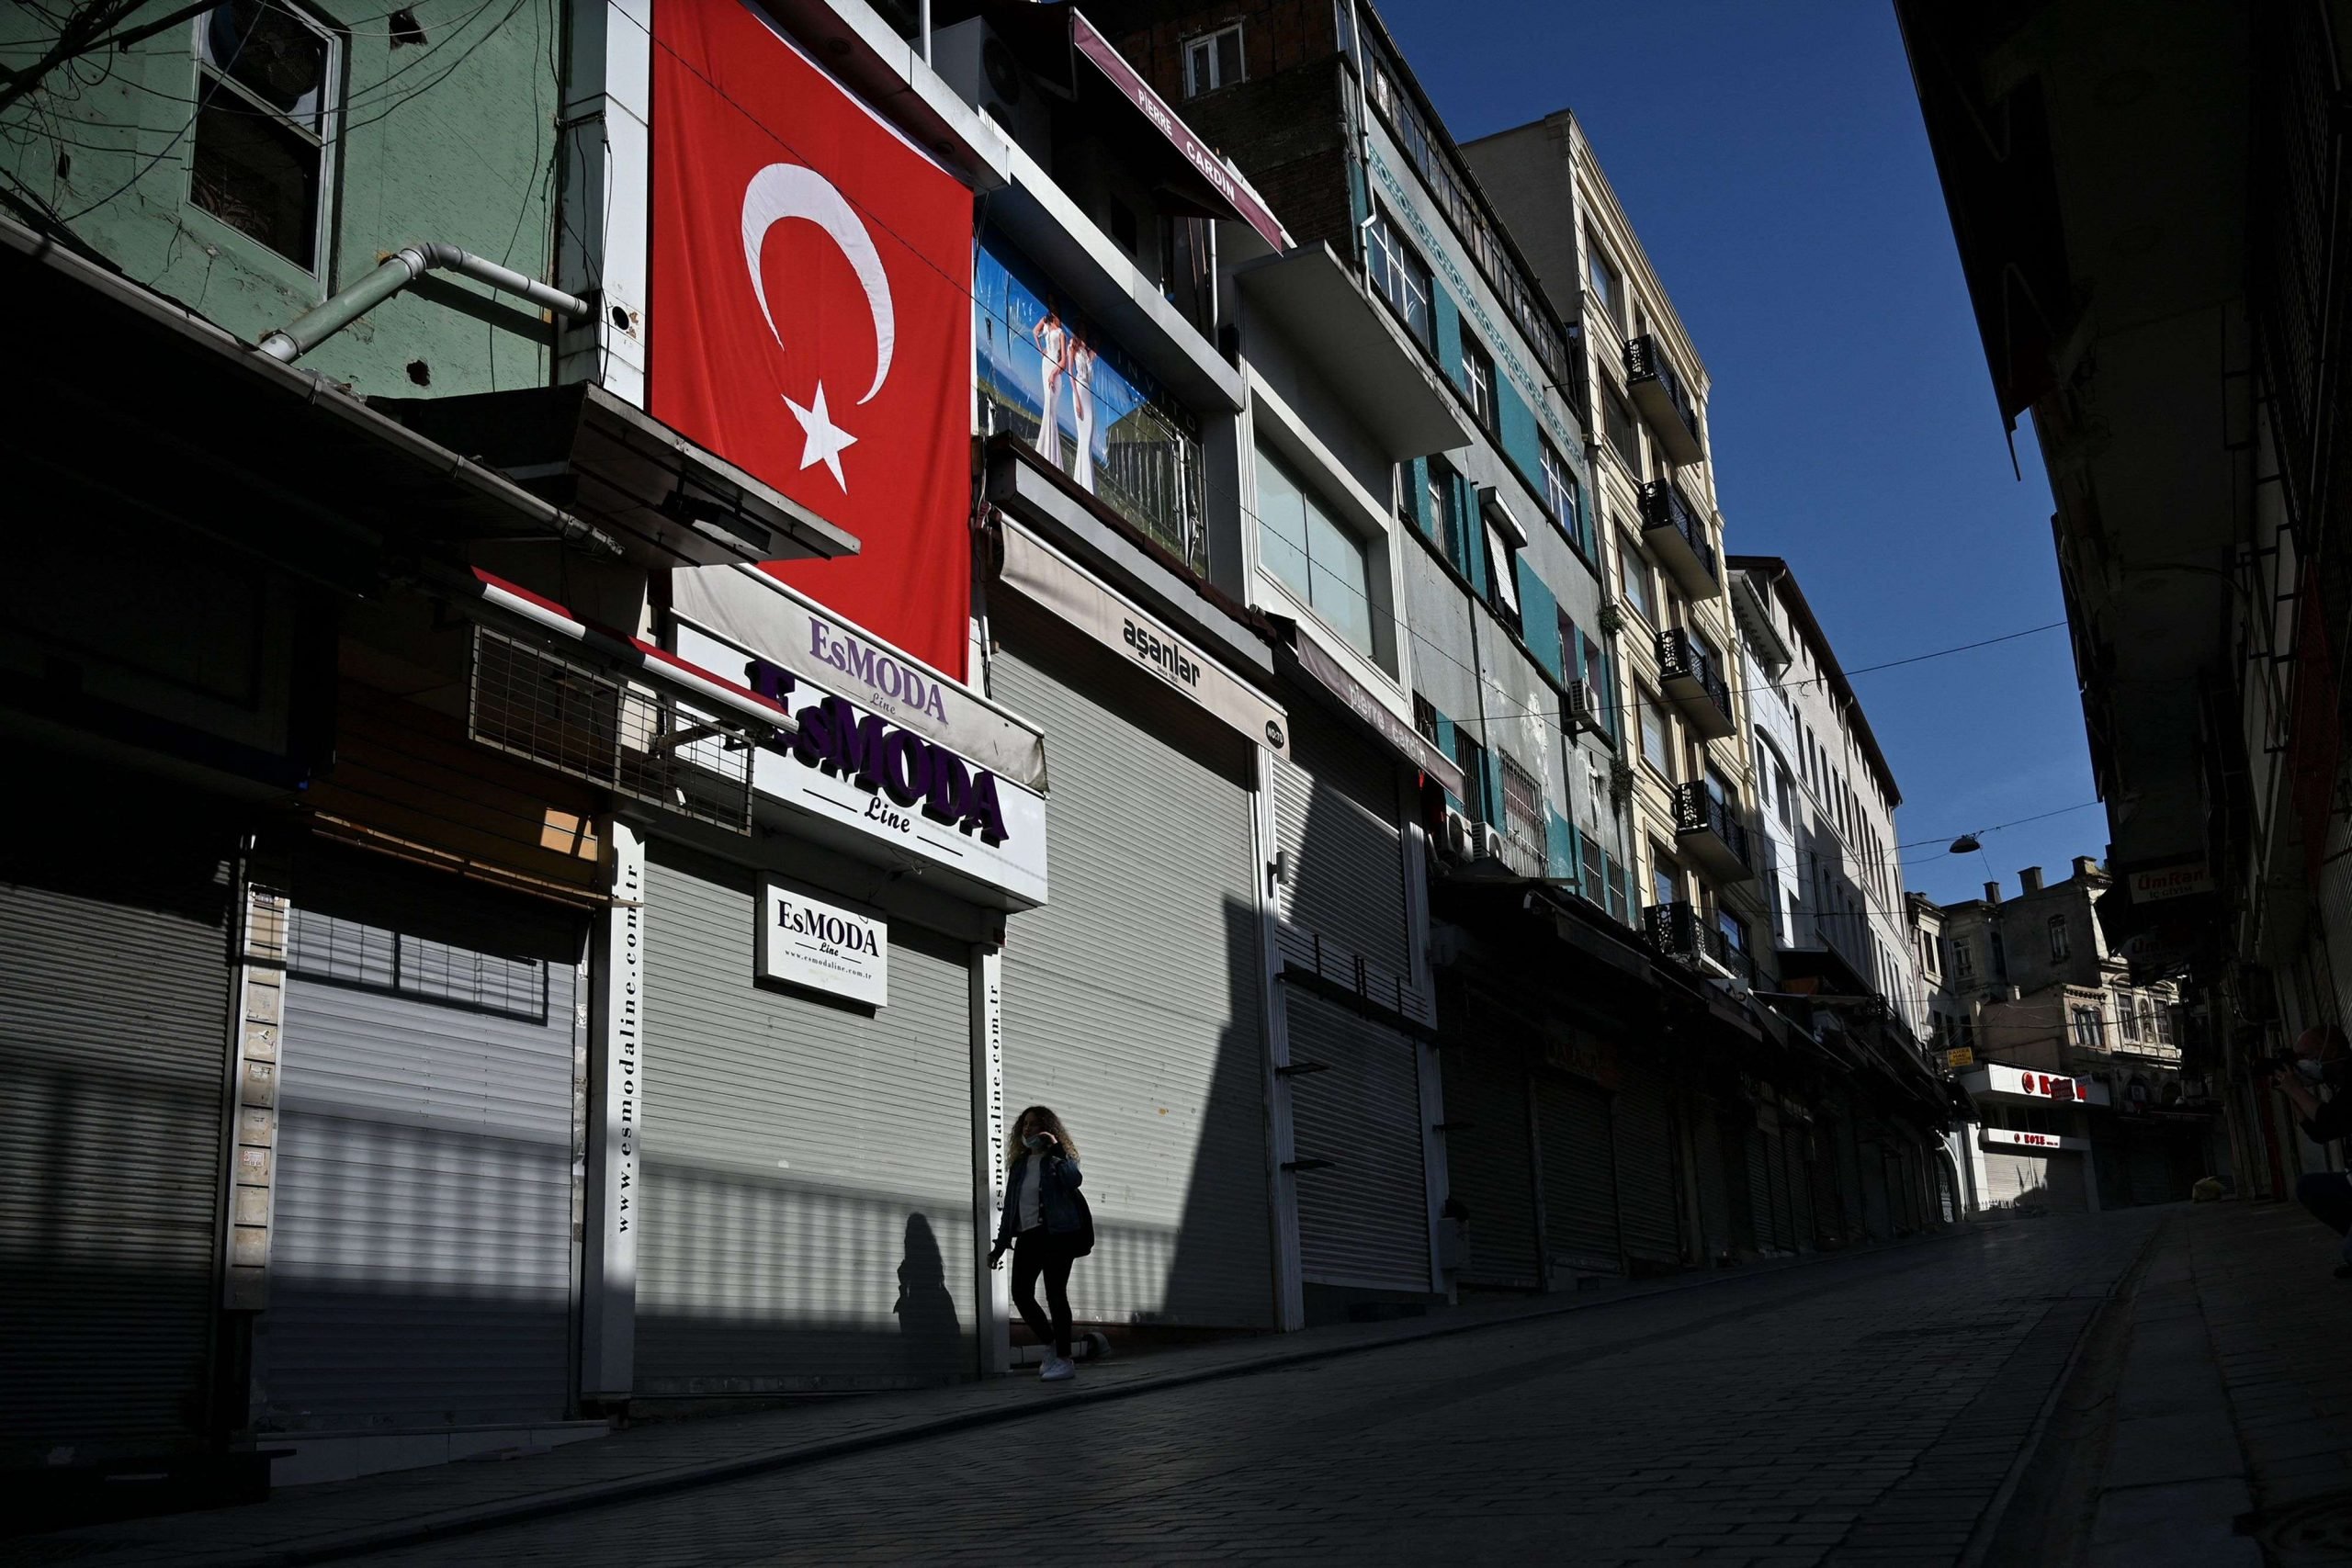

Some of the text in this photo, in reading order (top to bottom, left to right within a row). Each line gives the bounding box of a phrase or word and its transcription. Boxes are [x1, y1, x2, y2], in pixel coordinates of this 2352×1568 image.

[808, 615, 949, 726] EsMODA
[1123, 616, 1201, 687] aşanlar
[870, 692, 897, 716] Line
[1348, 682, 1428, 768] pierre cardin
[864, 796, 911, 833] Line
[777, 898, 880, 958] EsMODA
[819, 942, 840, 957] Line
